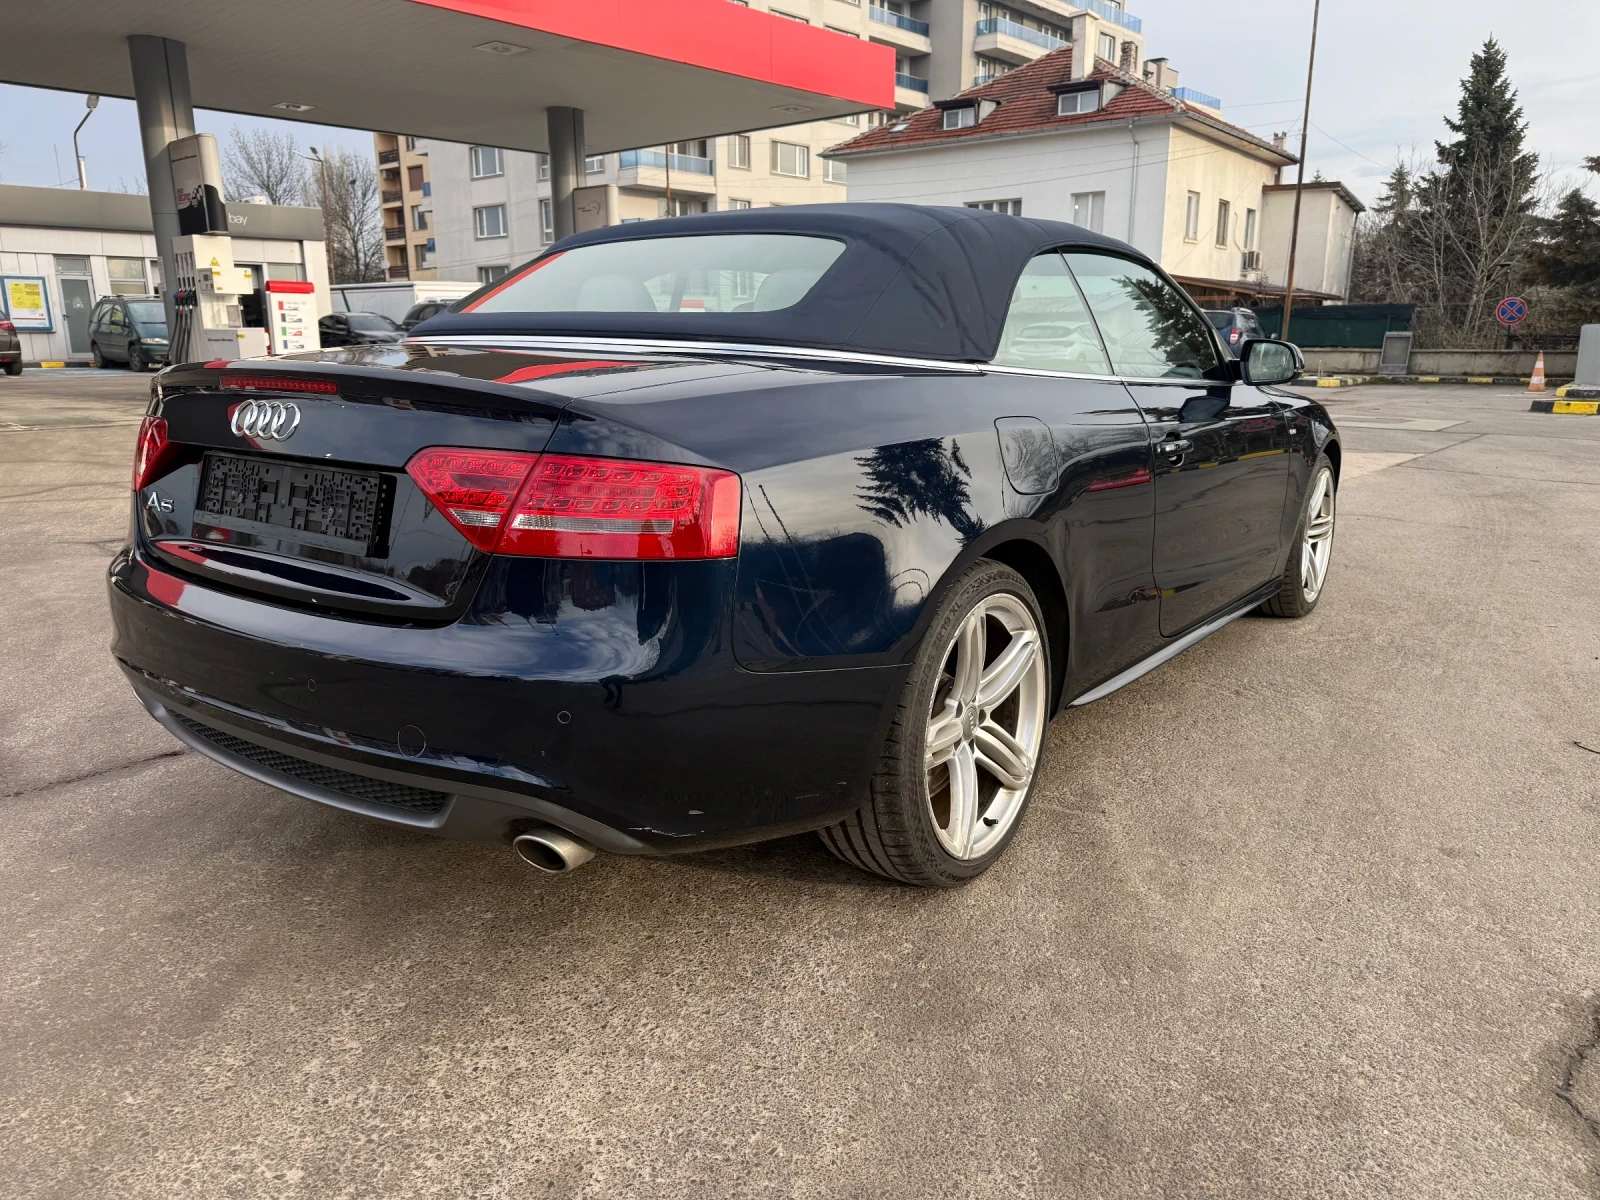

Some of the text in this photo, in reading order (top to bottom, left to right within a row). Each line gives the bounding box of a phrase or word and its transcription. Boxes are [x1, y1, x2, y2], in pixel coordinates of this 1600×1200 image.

[228, 213, 247, 225] bay
[146, 491, 173, 513] A5
[949, 602, 963, 617] XL
